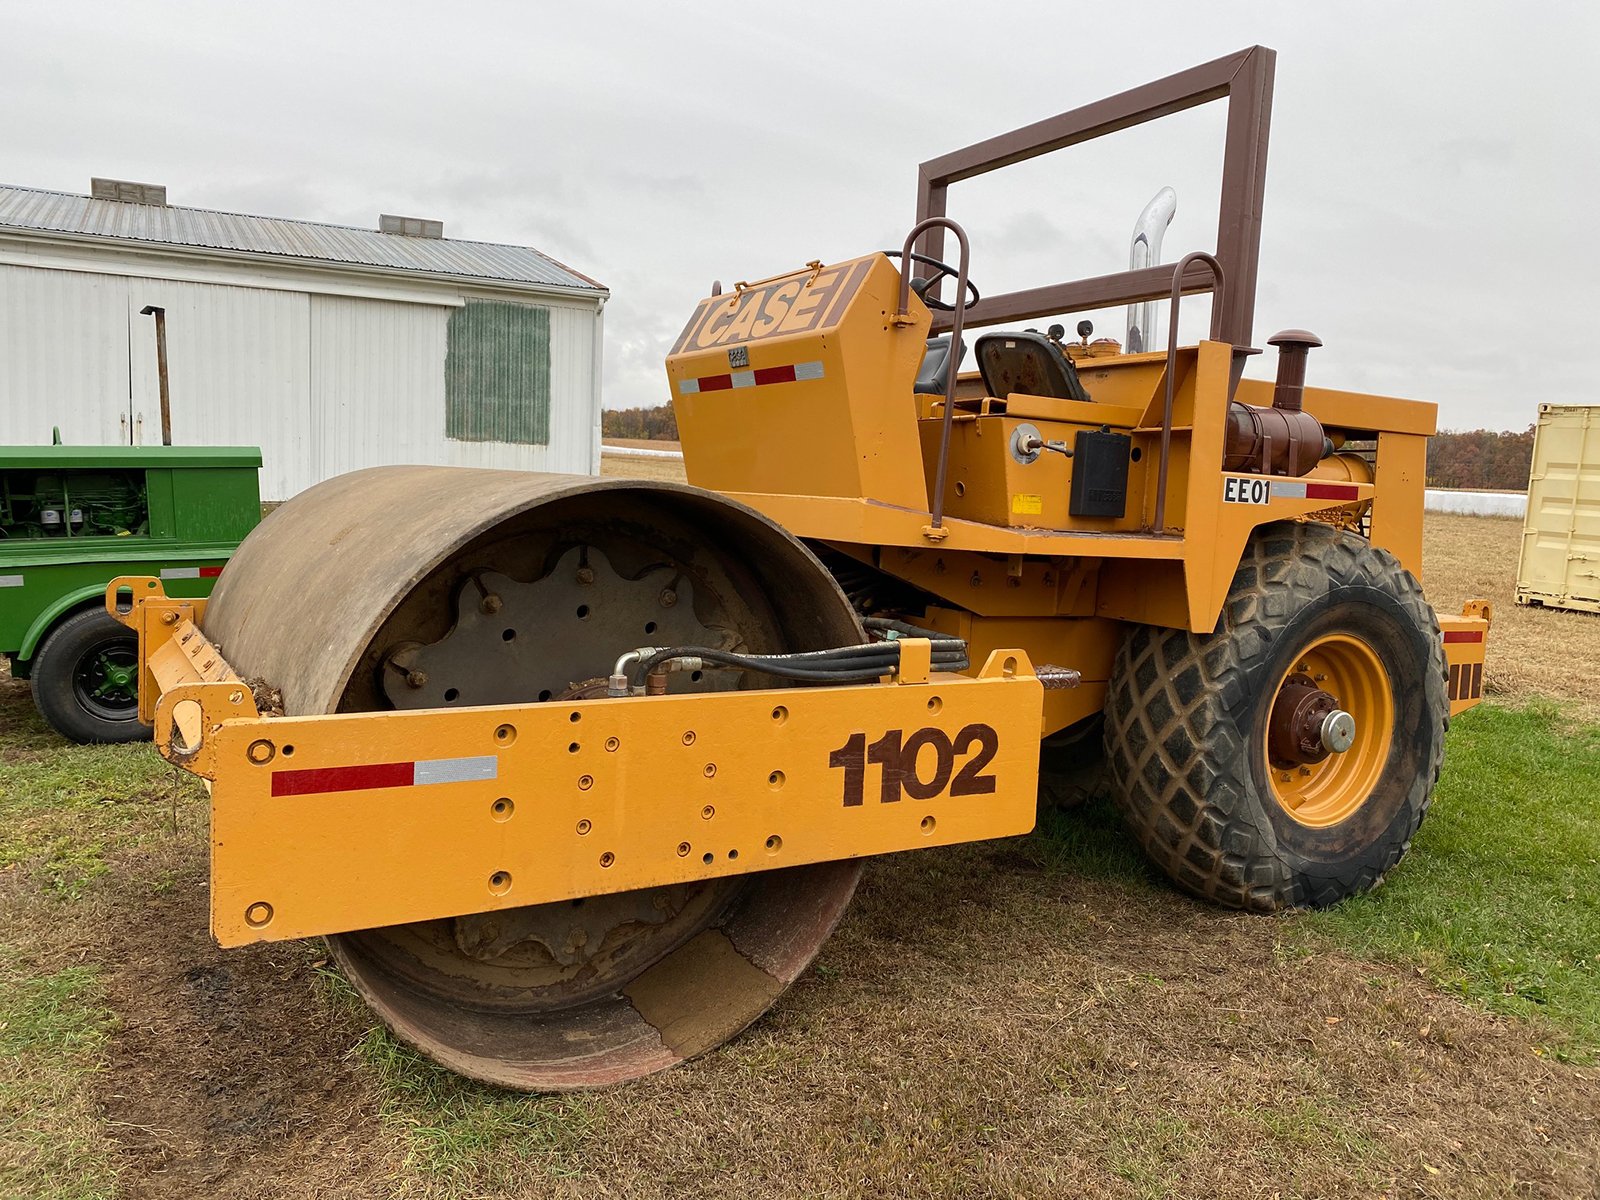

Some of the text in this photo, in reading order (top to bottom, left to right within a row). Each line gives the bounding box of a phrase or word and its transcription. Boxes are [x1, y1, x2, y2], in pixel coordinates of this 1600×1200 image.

[697, 272, 839, 348] CASE
[1225, 478, 1270, 504] EE01
[829, 723, 999, 807] 1102
